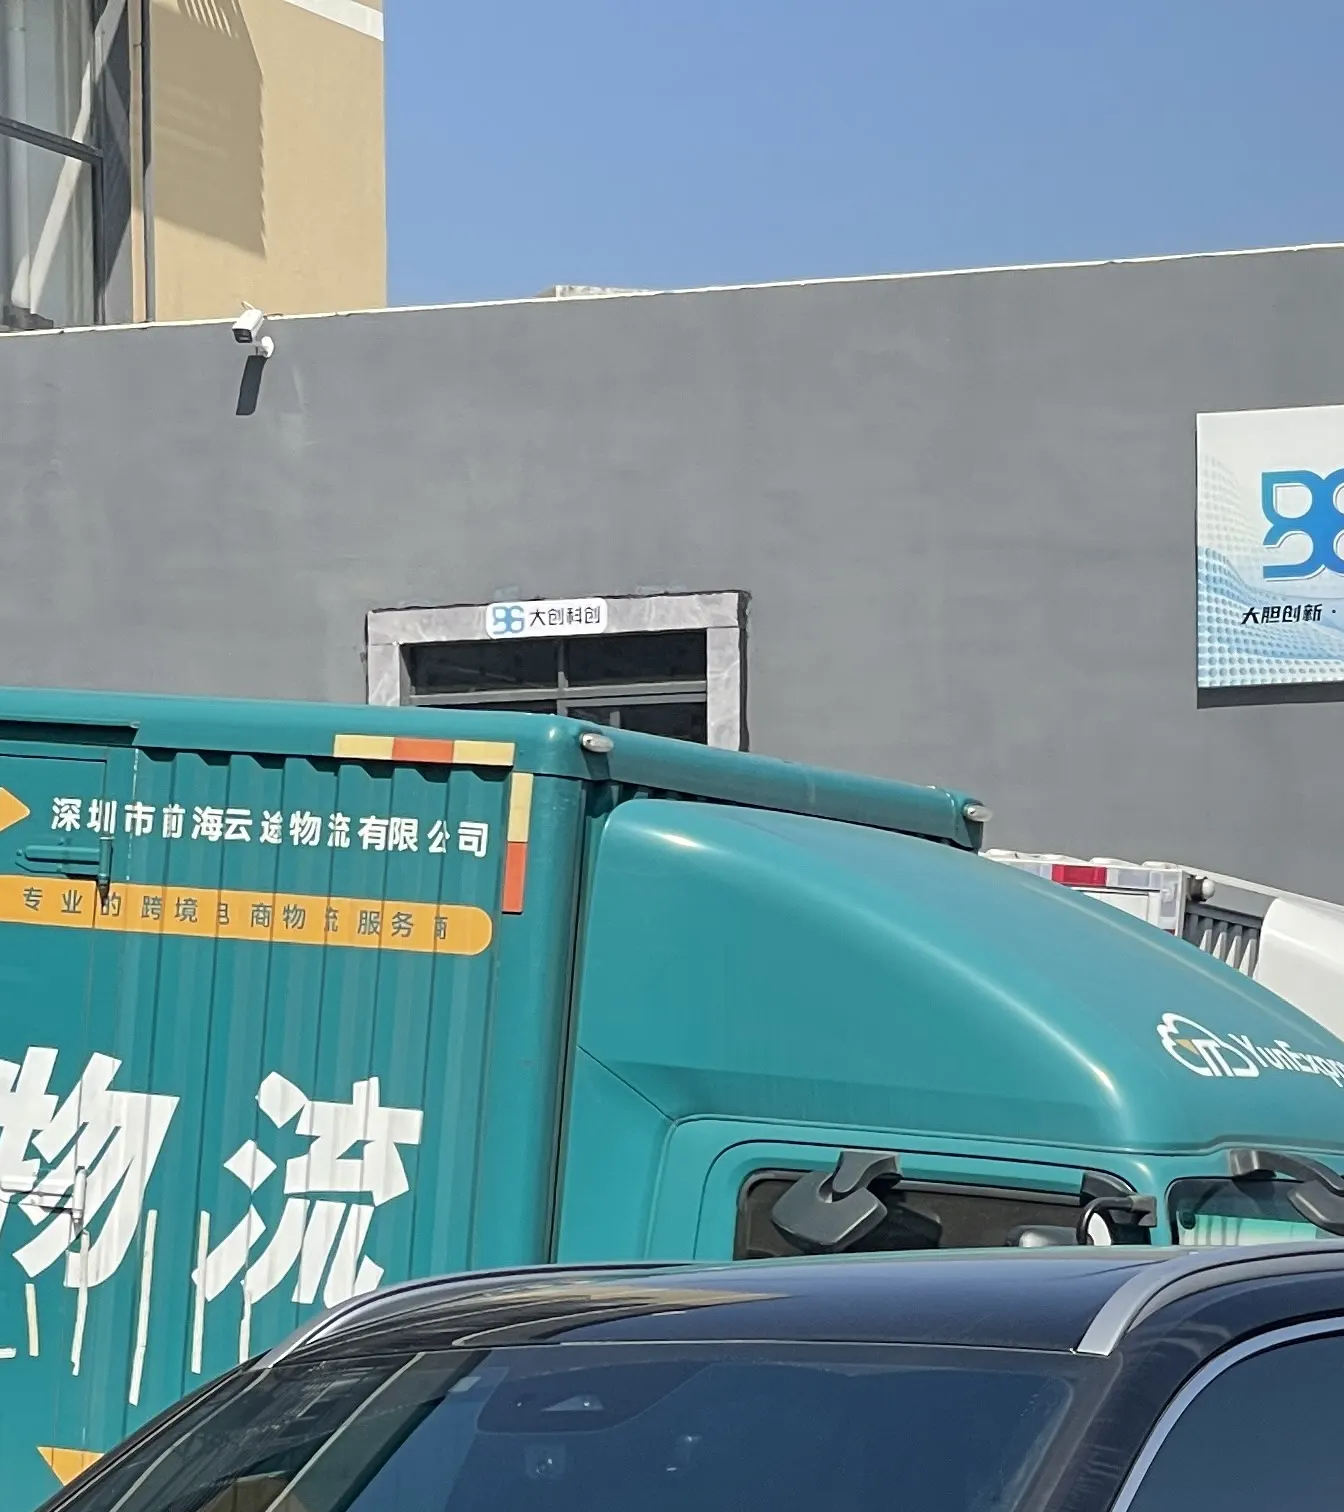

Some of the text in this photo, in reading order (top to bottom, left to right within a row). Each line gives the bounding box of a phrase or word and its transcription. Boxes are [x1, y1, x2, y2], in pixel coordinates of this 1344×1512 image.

[529, 605, 601, 627] 大创科创
[50, 796, 489, 858] 深圳市前海云途物流有限公司
